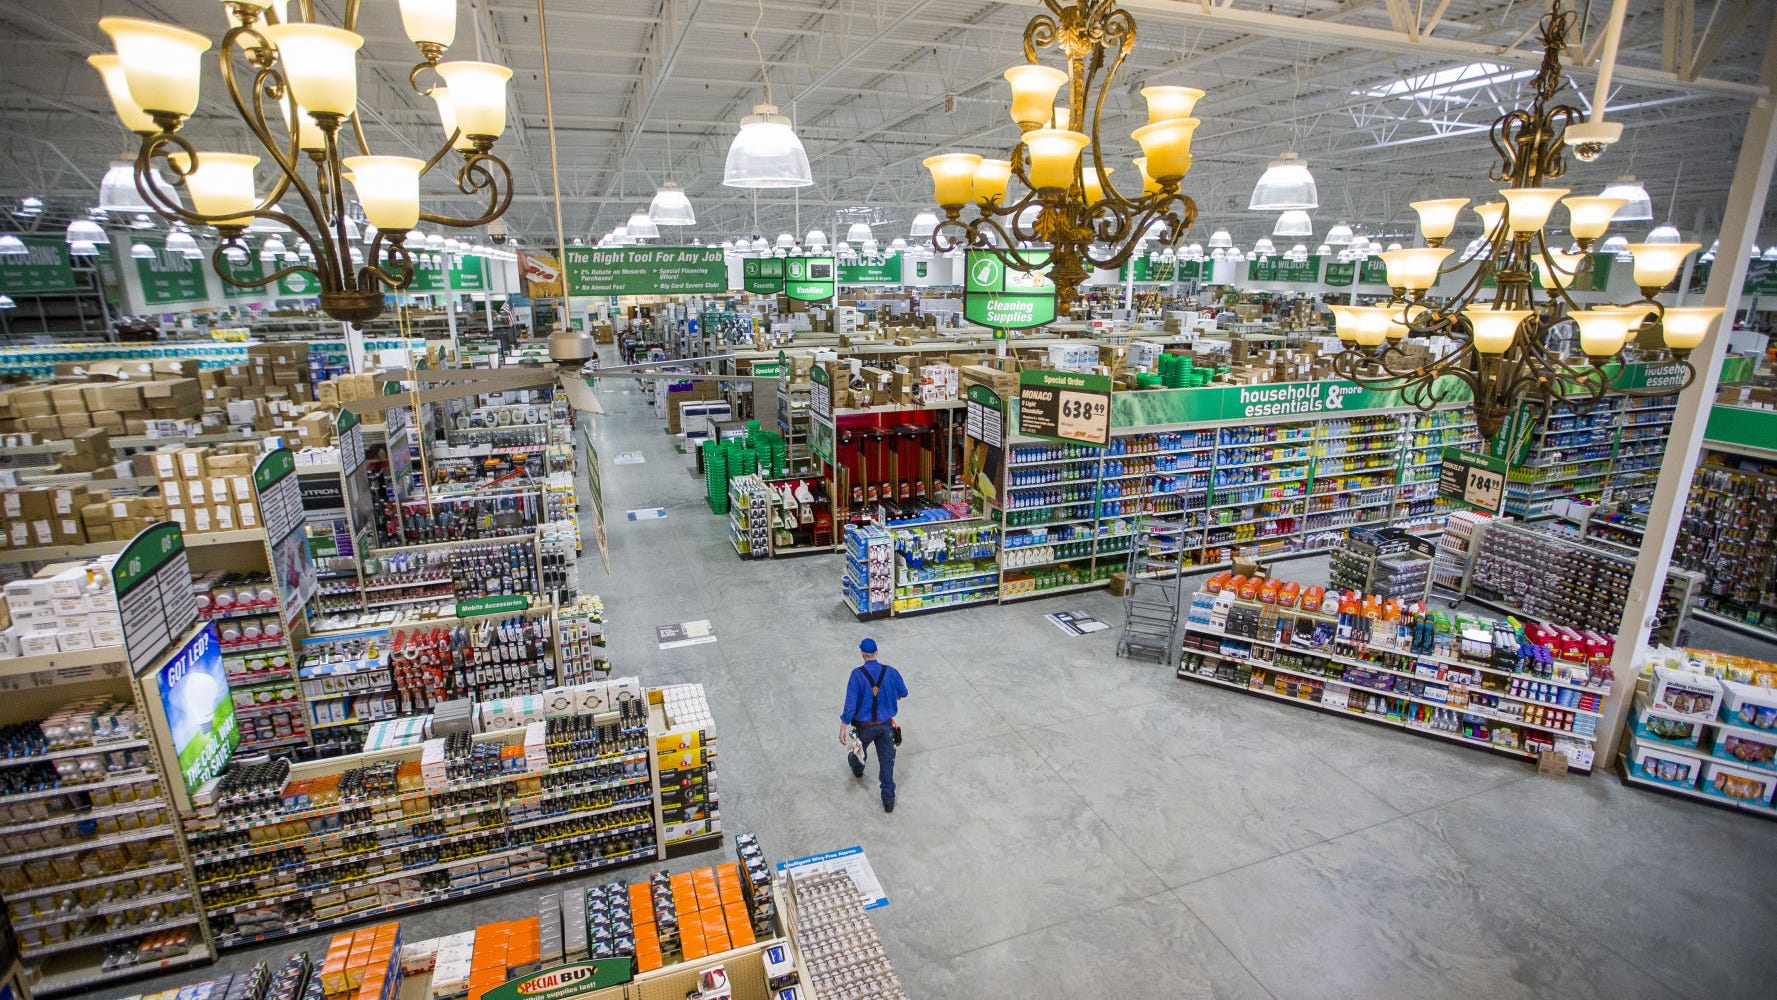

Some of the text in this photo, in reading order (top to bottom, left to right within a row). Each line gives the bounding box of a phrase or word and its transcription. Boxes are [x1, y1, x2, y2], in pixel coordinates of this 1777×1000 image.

[568, 250, 723, 266] The Right Tool For Any Job
[1279, 260, 1310, 270] WILDLIFE
[681, 267, 709, 275] Financing
[797, 286, 824, 294] Vanities
[986, 300, 1034, 313] Cleaning
[986, 311, 1033, 324] Supplies
[1043, 375, 1086, 387] Special Order
[1021, 389, 1053, 402] MONACO
[1240, 382, 1320, 404] household
[1325, 384, 1364, 409] & more
[1062, 398, 1093, 421] 638
[1245, 397, 1323, 417] essentials
[1470, 473, 1491, 493] 784
[129, 556, 142, 577] 06
[461, 599, 523, 612] Mobile Accessories
[168, 632, 209, 688] GOT LED?
[186, 712, 234, 787] THE COOL WAY
[211, 739, 232, 776] SAVE!
[838, 848, 857, 858] Alarms
[518, 966, 597, 994] SPECIAL BUY
[546, 986, 578, 999] supplies
[579, 981, 597, 991] last!
